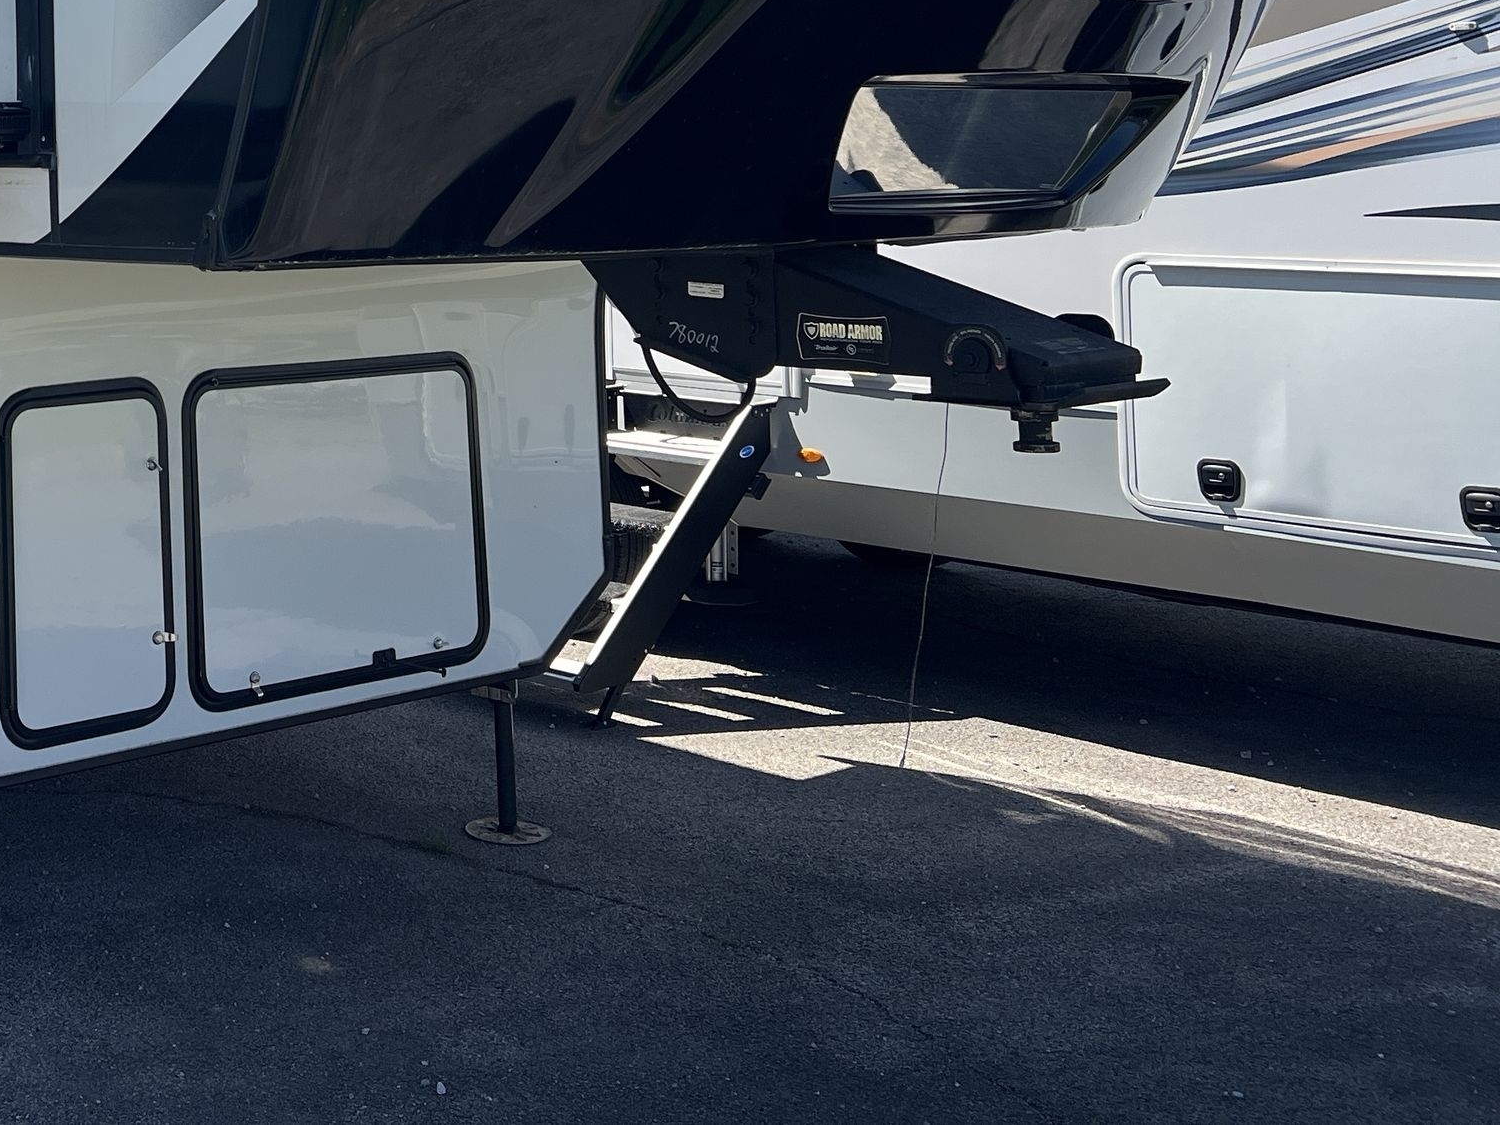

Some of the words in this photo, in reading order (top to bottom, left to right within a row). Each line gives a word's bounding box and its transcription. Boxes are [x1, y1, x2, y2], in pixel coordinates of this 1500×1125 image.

[668, 321, 720, 354] 780012
[819, 322, 846, 339] ROAD
[847, 323, 883, 341] ARMOR
